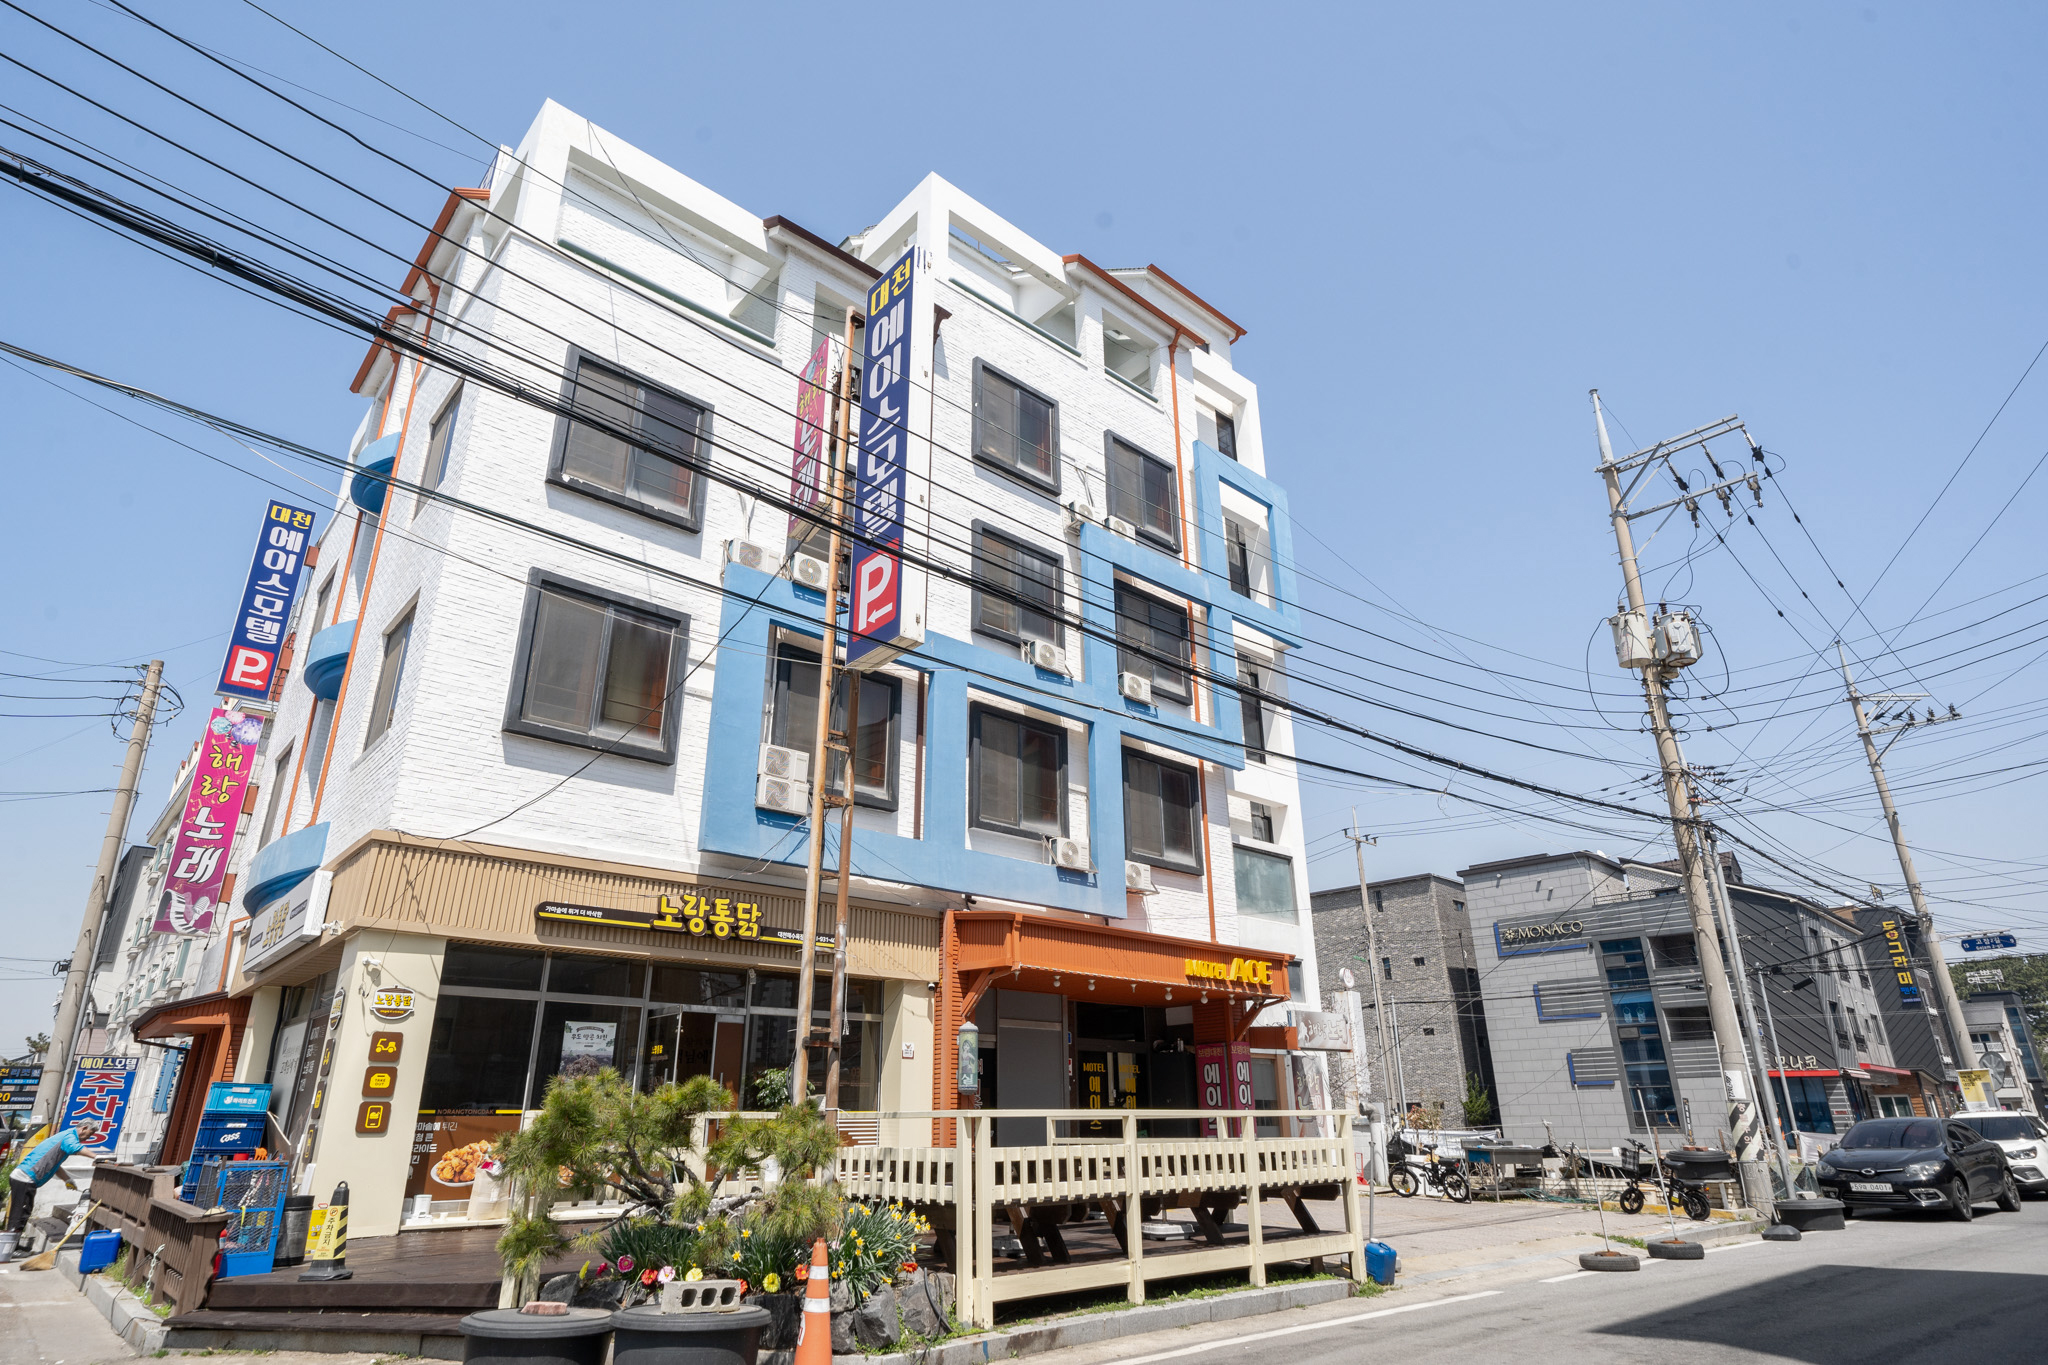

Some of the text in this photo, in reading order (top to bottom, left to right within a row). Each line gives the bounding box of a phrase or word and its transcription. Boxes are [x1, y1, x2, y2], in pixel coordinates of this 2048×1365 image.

[870, 257, 911, 316] 대천
[863, 298, 905, 540] 에이스모텔
[270, 504, 312, 530] 대천
[245, 525, 305, 645] 에이스모텔
[199, 744, 244, 804] 해랑
[172, 806, 227, 885] 노래
[652, 894, 763, 939] 노랑통닭
[1518, 920, 1583, 939] MONACO
[1882, 920, 1913, 985] 동그라미
[1229, 957, 1274, 985] ACE
[375, 994, 412, 1007] 노랑통닭
[80, 1058, 137, 1069] 에이스모텔
[1083, 1063, 1105, 1072] MOTEL
[1774, 1054, 1819, 1070] 모나코
[412, 1143, 437, 1153] 라이드
[323, 1218, 335, 1245] 주차금지
